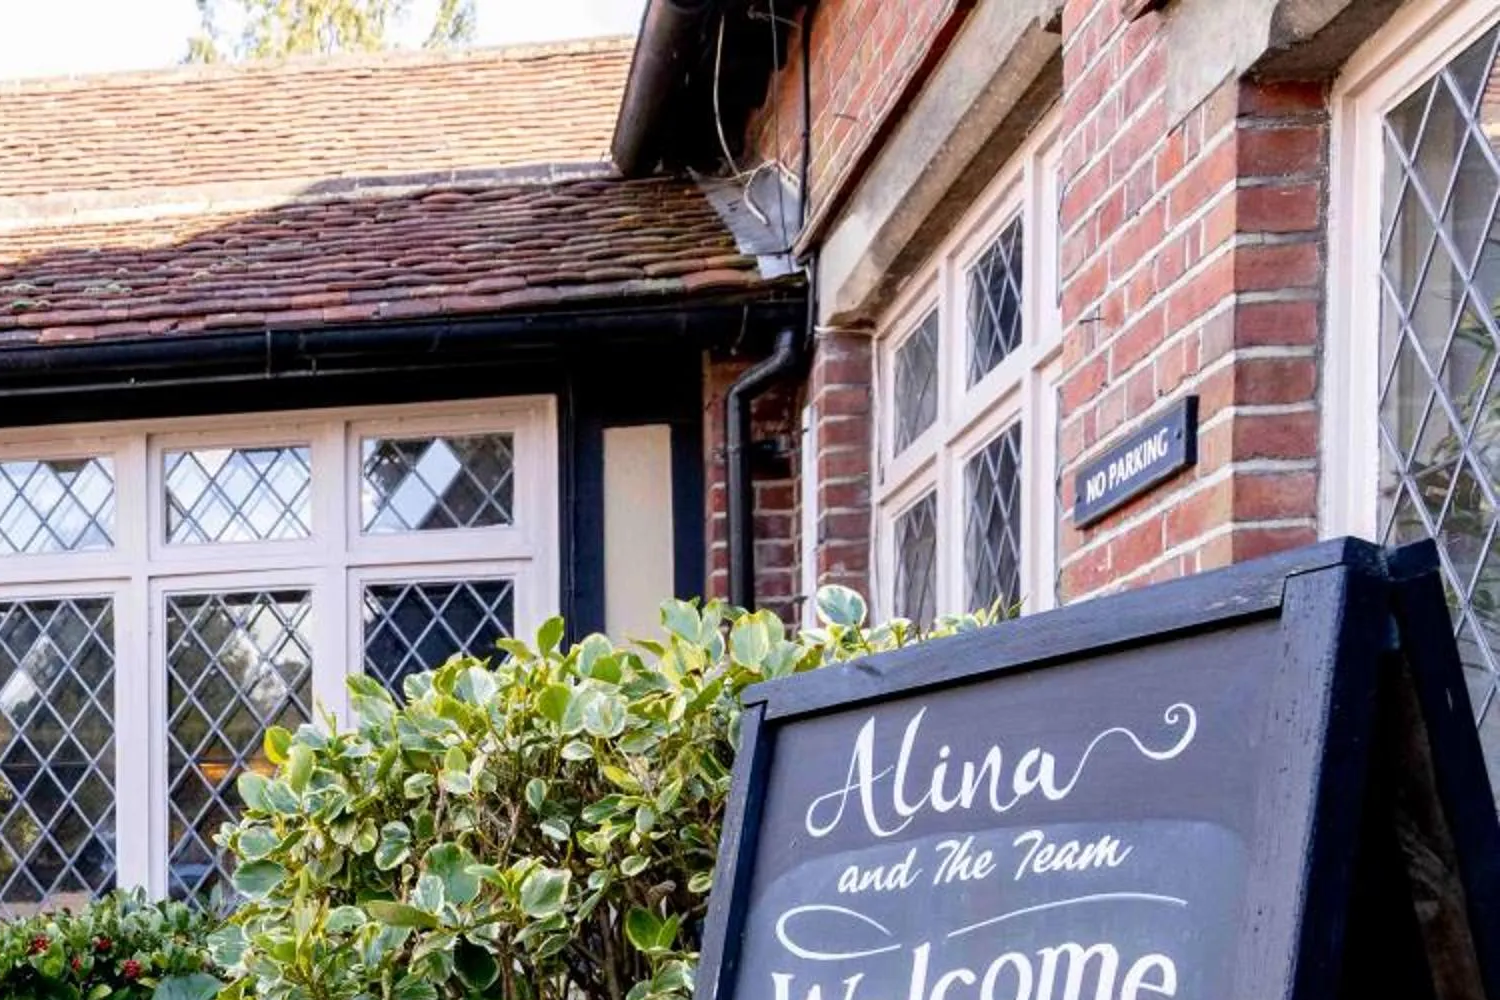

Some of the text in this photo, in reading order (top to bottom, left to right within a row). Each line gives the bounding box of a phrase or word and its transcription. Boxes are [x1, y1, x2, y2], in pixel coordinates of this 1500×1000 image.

[1086, 428, 1168, 504] NO PARKING
[805, 702, 1197, 838] Alina
[838, 830, 1133, 893] and The Team
